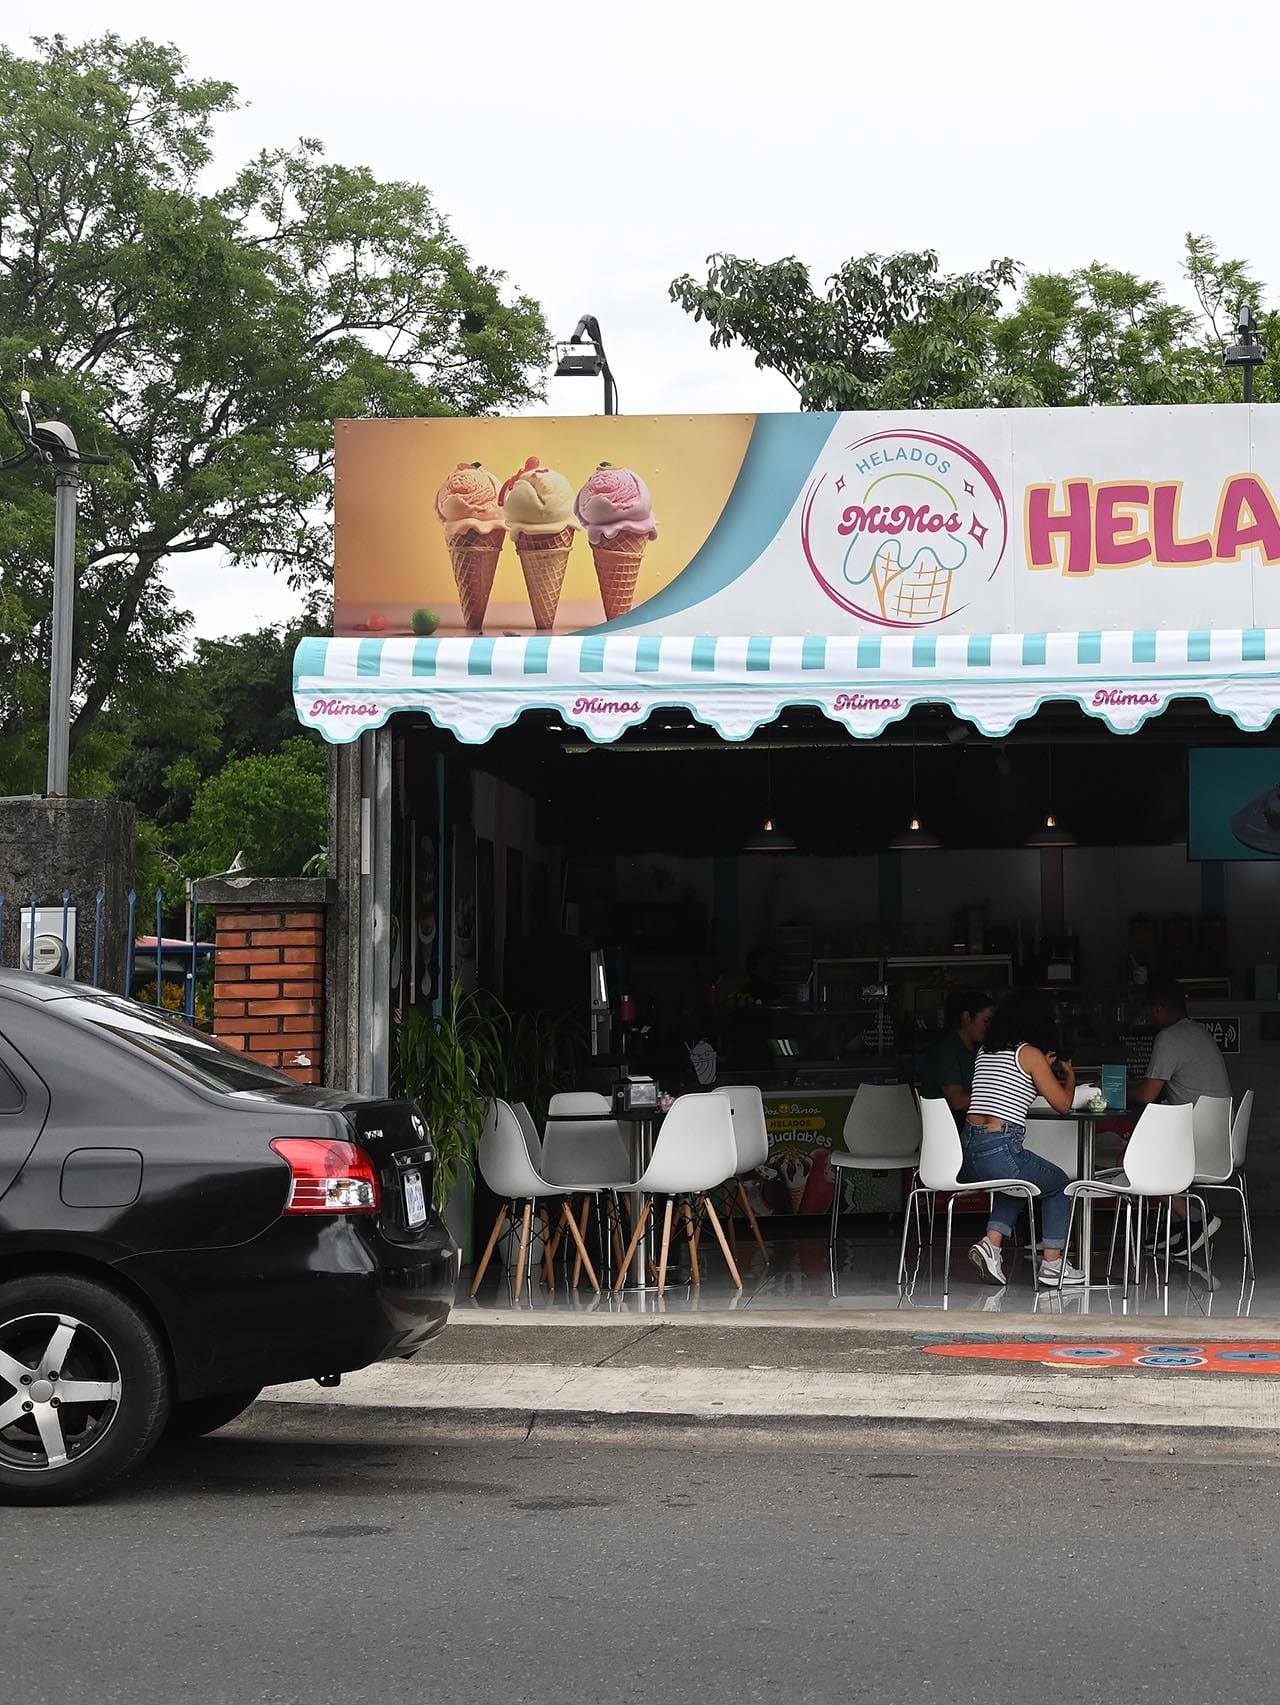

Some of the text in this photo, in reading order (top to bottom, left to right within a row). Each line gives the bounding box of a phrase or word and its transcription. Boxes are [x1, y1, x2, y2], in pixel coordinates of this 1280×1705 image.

[855, 447, 951, 474] HELADOS
[837, 504, 963, 536] MiMos
[573, 698, 641, 715] Mimos
[835, 694, 901, 711] Mimos
[1093, 690, 1159, 707] Mimos
[310, 700, 379, 717] Mimos
[790, 1103, 822, 1114] Pinos
[770, 1120, 810, 1128] HELADOS
